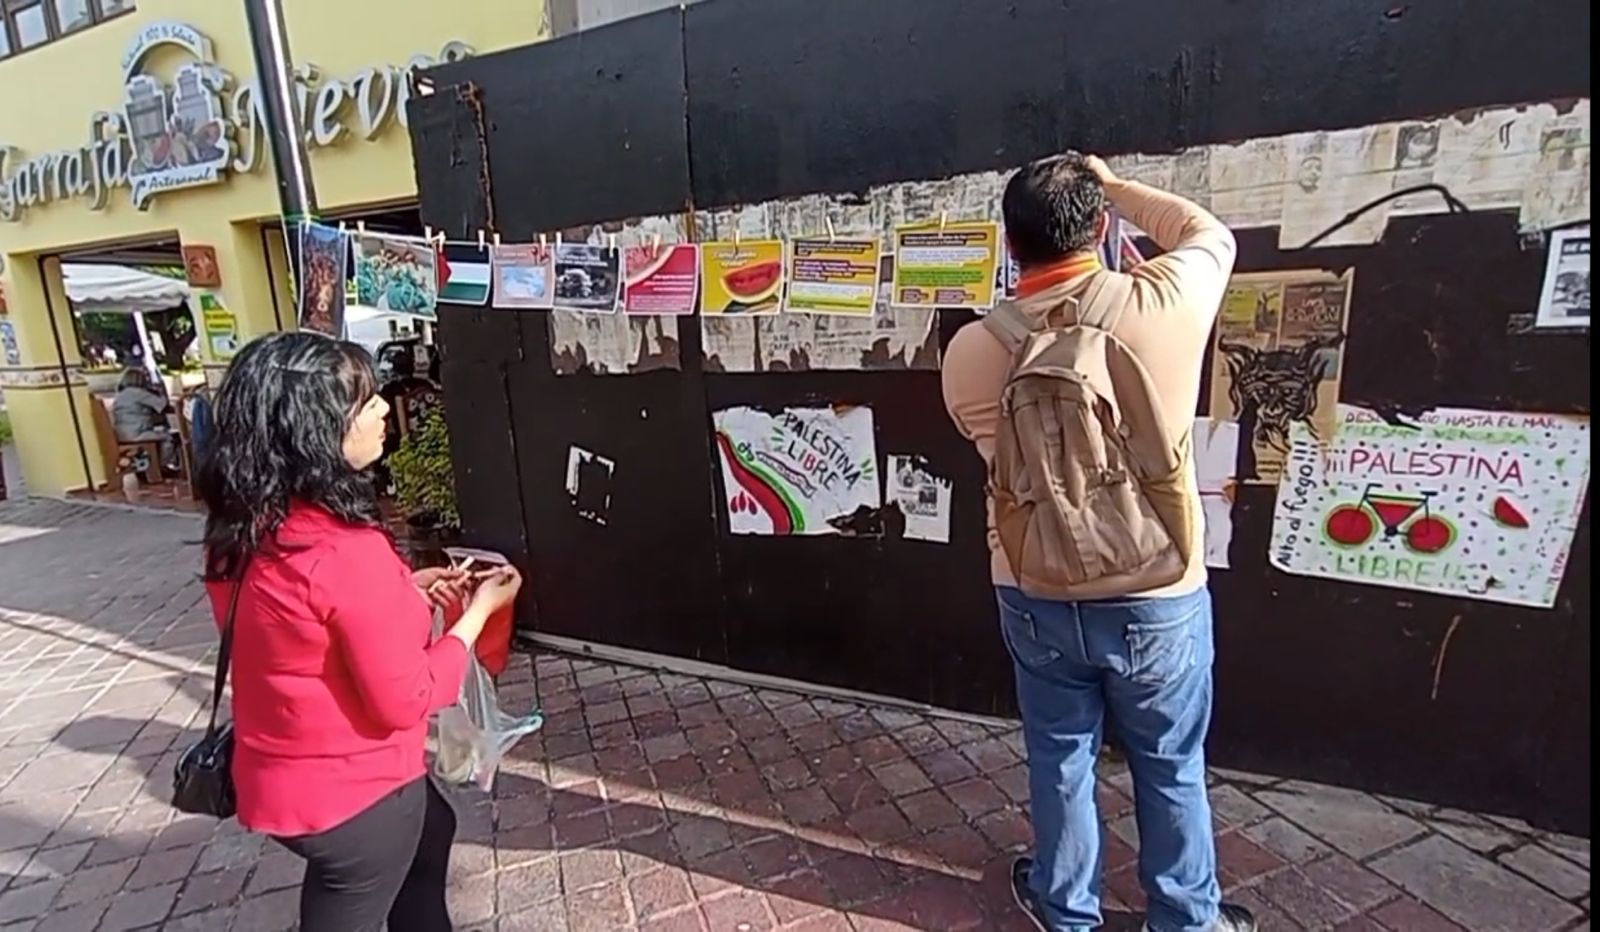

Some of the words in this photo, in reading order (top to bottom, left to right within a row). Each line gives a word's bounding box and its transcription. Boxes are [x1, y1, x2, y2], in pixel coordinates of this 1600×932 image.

[149, 167, 212, 190] Artesanal
[1446, 415, 1494, 428] HASTA
[1497, 415, 1518, 428] EL
[784, 411, 861, 490] PALESTINA
[788, 440, 839, 490] LIBRE
[1276, 532, 1299, 567] Alto
